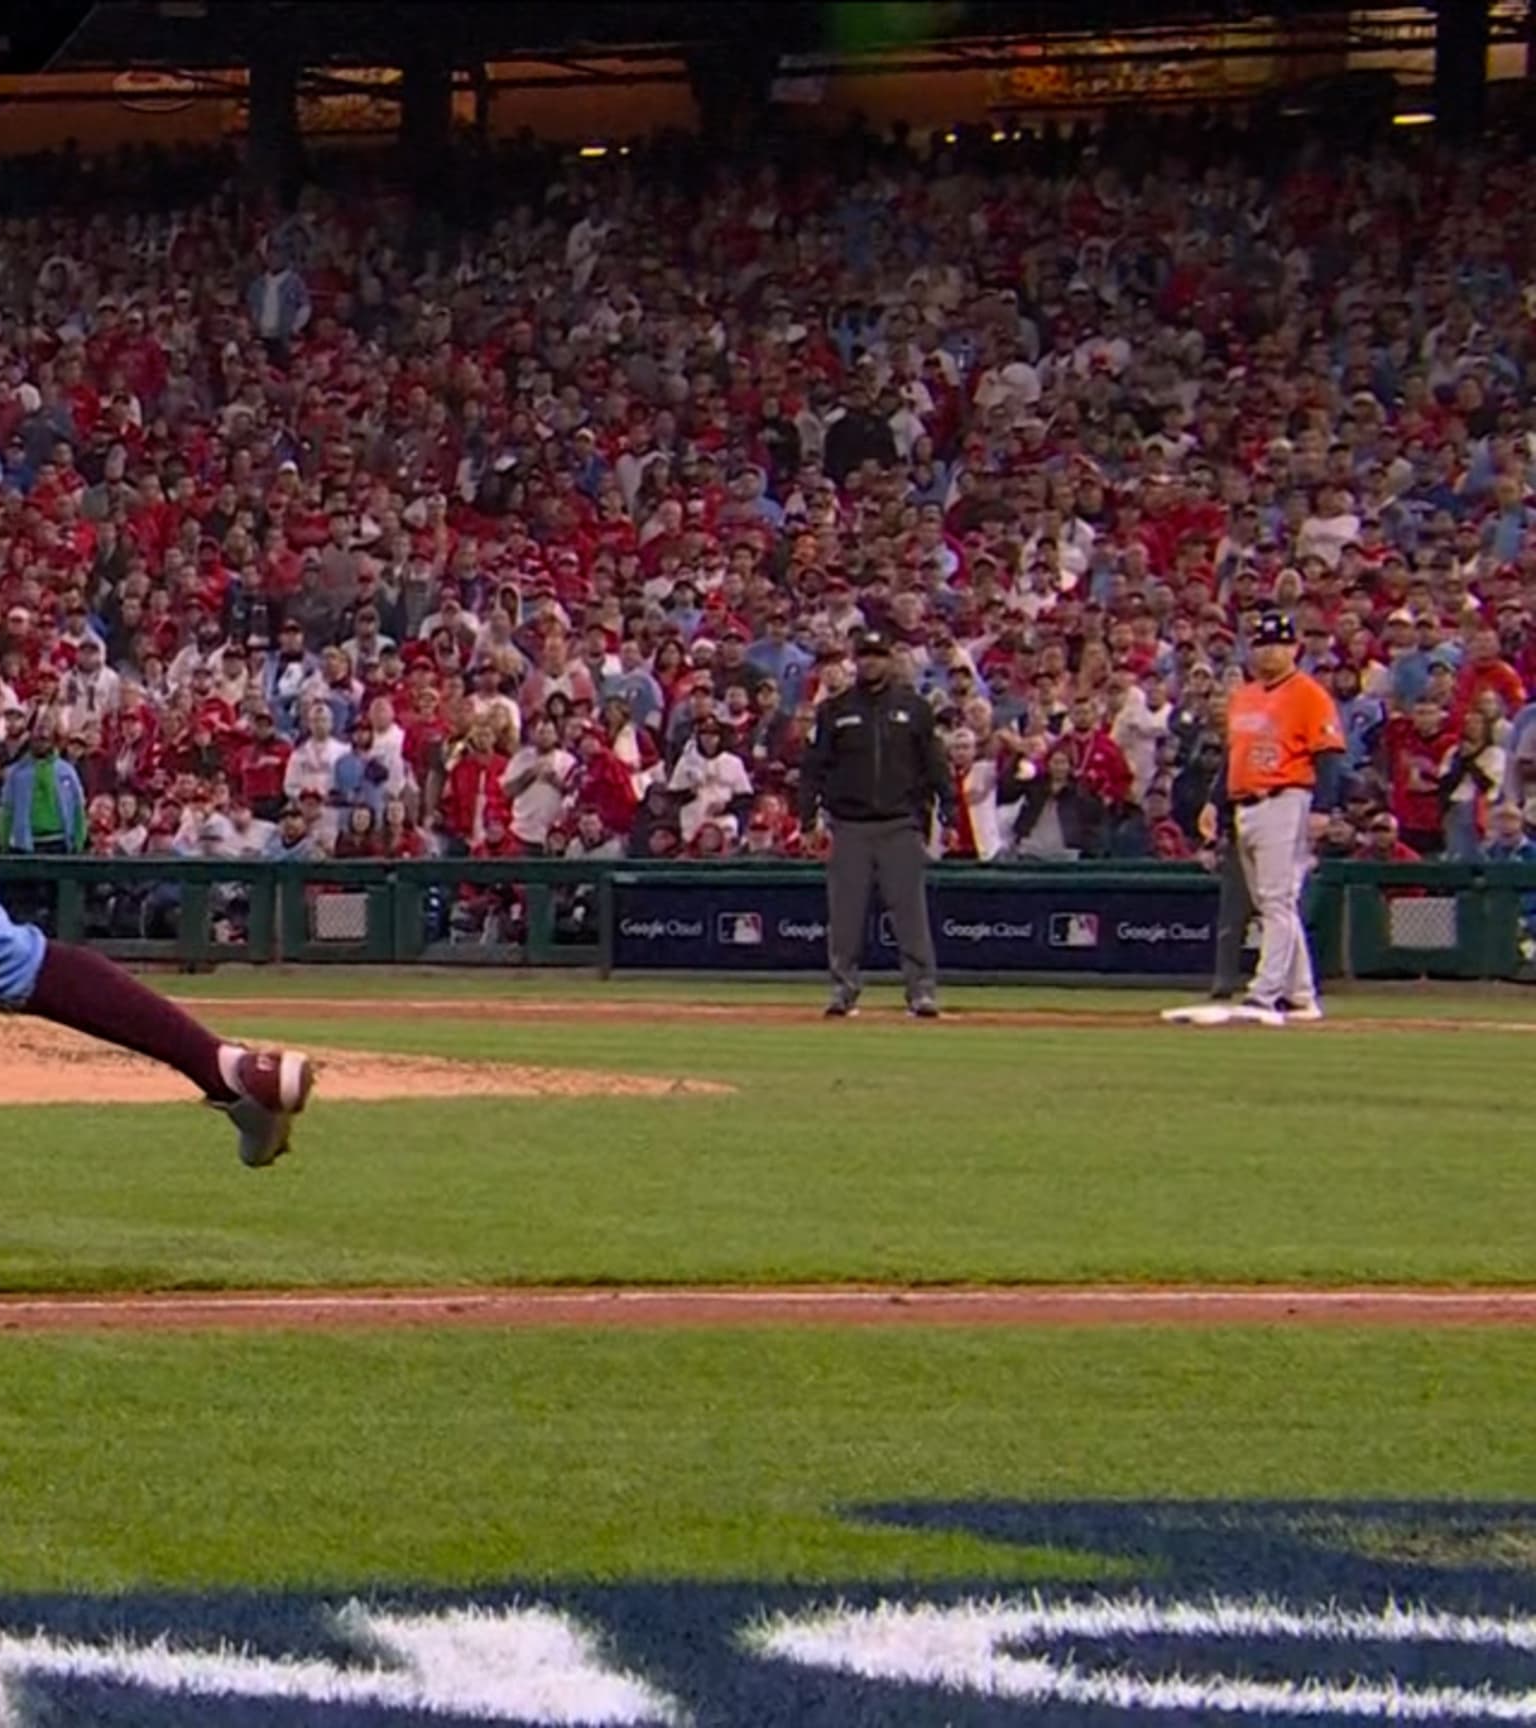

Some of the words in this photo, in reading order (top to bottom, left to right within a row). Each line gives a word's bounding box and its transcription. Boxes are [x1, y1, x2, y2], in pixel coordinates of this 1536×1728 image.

[619, 918, 664, 938] Google
[666, 920, 703, 936] Cloud
[778, 919, 825, 940] Google
[942, 919, 991, 941] Google
[992, 922, 1033, 938] Cloud
[1117, 921, 1167, 942] Google
[1168, 922, 1210, 940] Cloud
